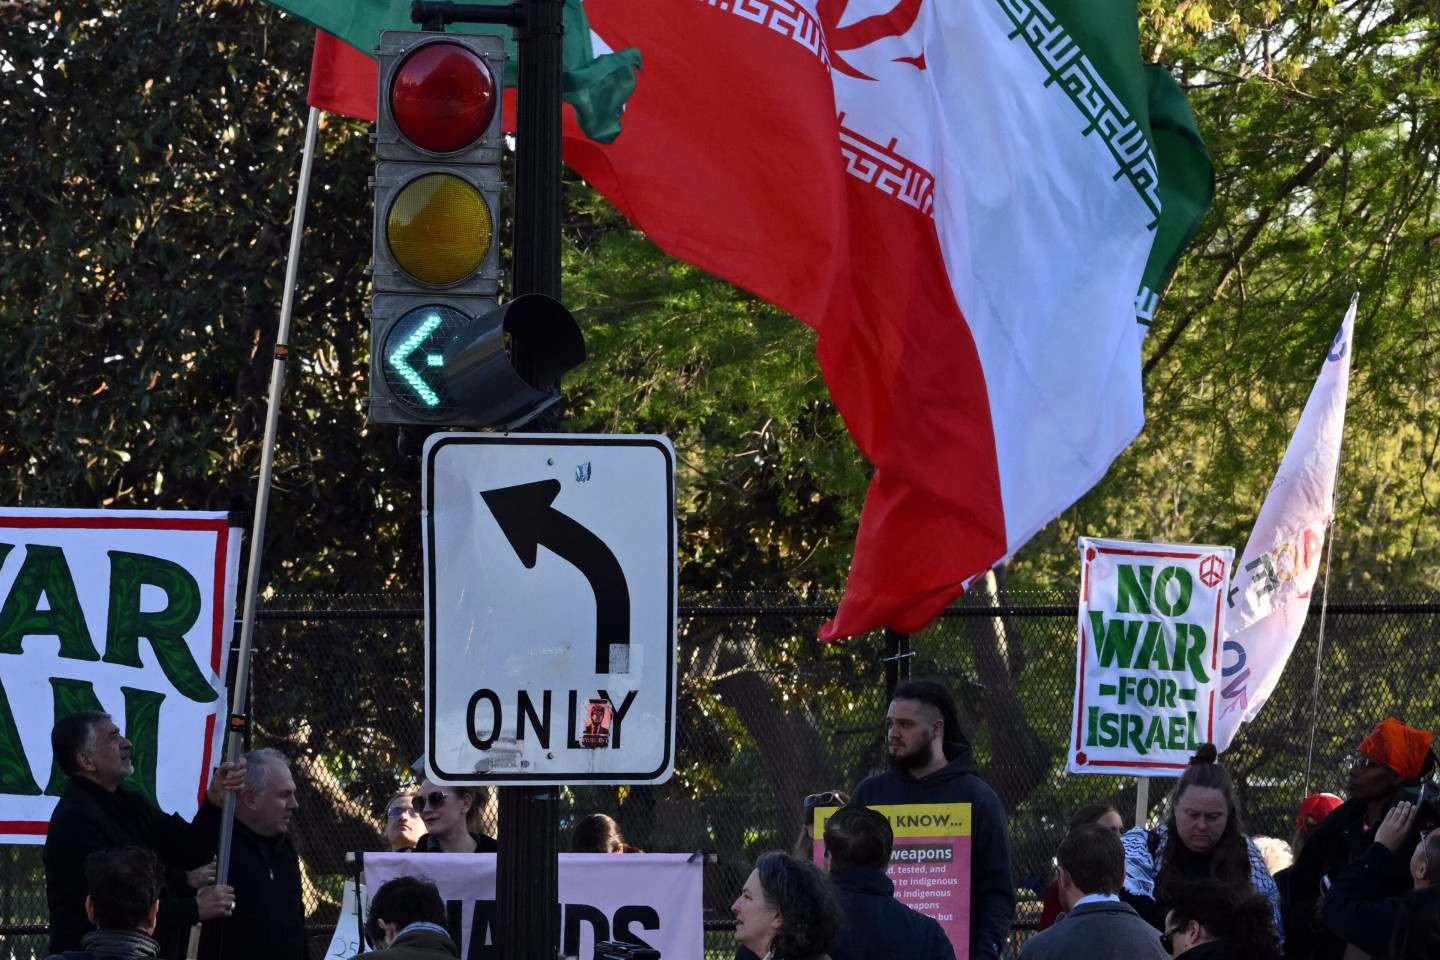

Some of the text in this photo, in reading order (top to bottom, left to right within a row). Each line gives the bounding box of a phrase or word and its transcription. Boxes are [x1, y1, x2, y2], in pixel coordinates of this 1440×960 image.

[1116, 564, 1192, 617] NO
[1089, 611, 1210, 683] WAR
[466, 688, 639, 750] ONLY
[1086, 706, 1201, 755] ISRAEL
[896, 814, 962, 827] KNOW...
[891, 848, 952, 862] weapons
[898, 866, 927, 874] tested,
[930, 865, 946, 873] and
[903, 890, 951, 898] Indigenous
